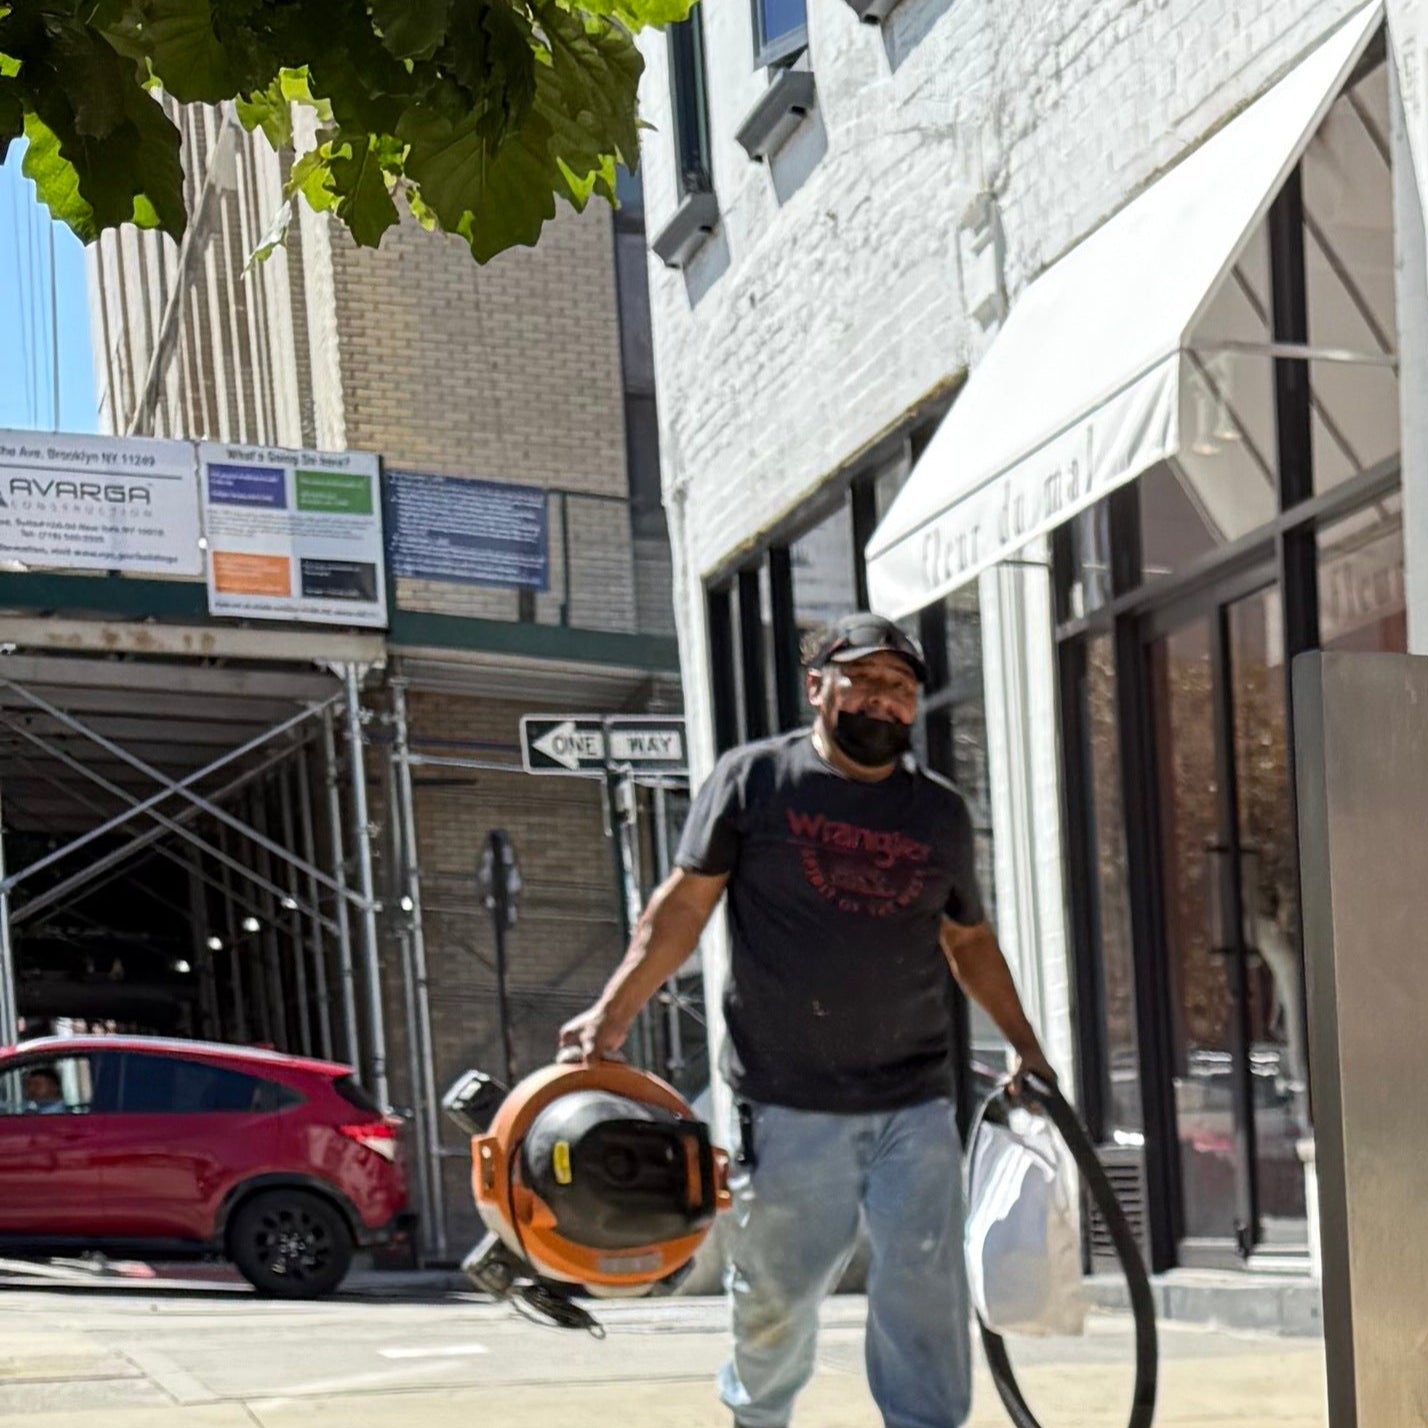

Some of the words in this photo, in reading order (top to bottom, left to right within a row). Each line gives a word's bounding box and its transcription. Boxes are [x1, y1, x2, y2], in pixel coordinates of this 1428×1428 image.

[47, 448, 99, 465] Brooklyn
[1044, 424, 1093, 519] mal
[9, 478, 151, 505] AVARGA
[552, 735, 597, 756] ONE
[626, 736, 672, 754] WAY
